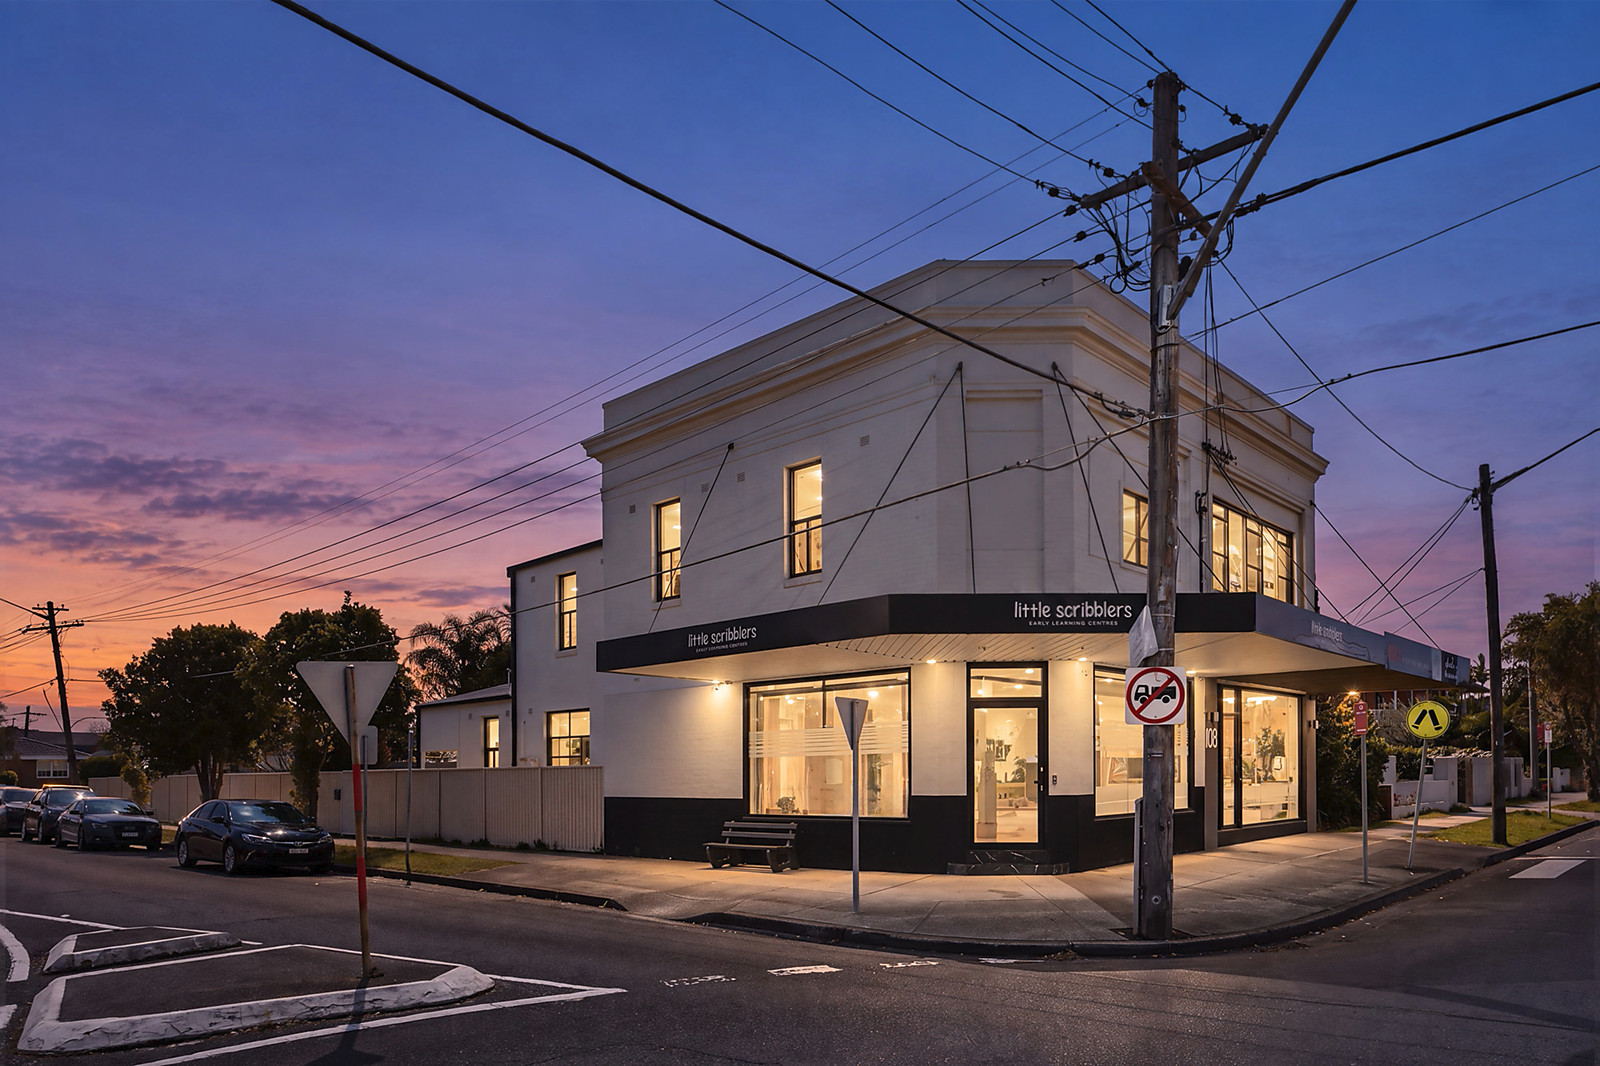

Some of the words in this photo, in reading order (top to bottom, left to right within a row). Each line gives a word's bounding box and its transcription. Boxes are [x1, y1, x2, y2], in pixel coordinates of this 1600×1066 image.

[1014, 601, 1051, 618] little
[1056, 601, 1132, 618] scribblers
[688, 632, 709, 647] little
[711, 626, 757, 644] scribblers
[1205, 728, 1218, 748] 108
